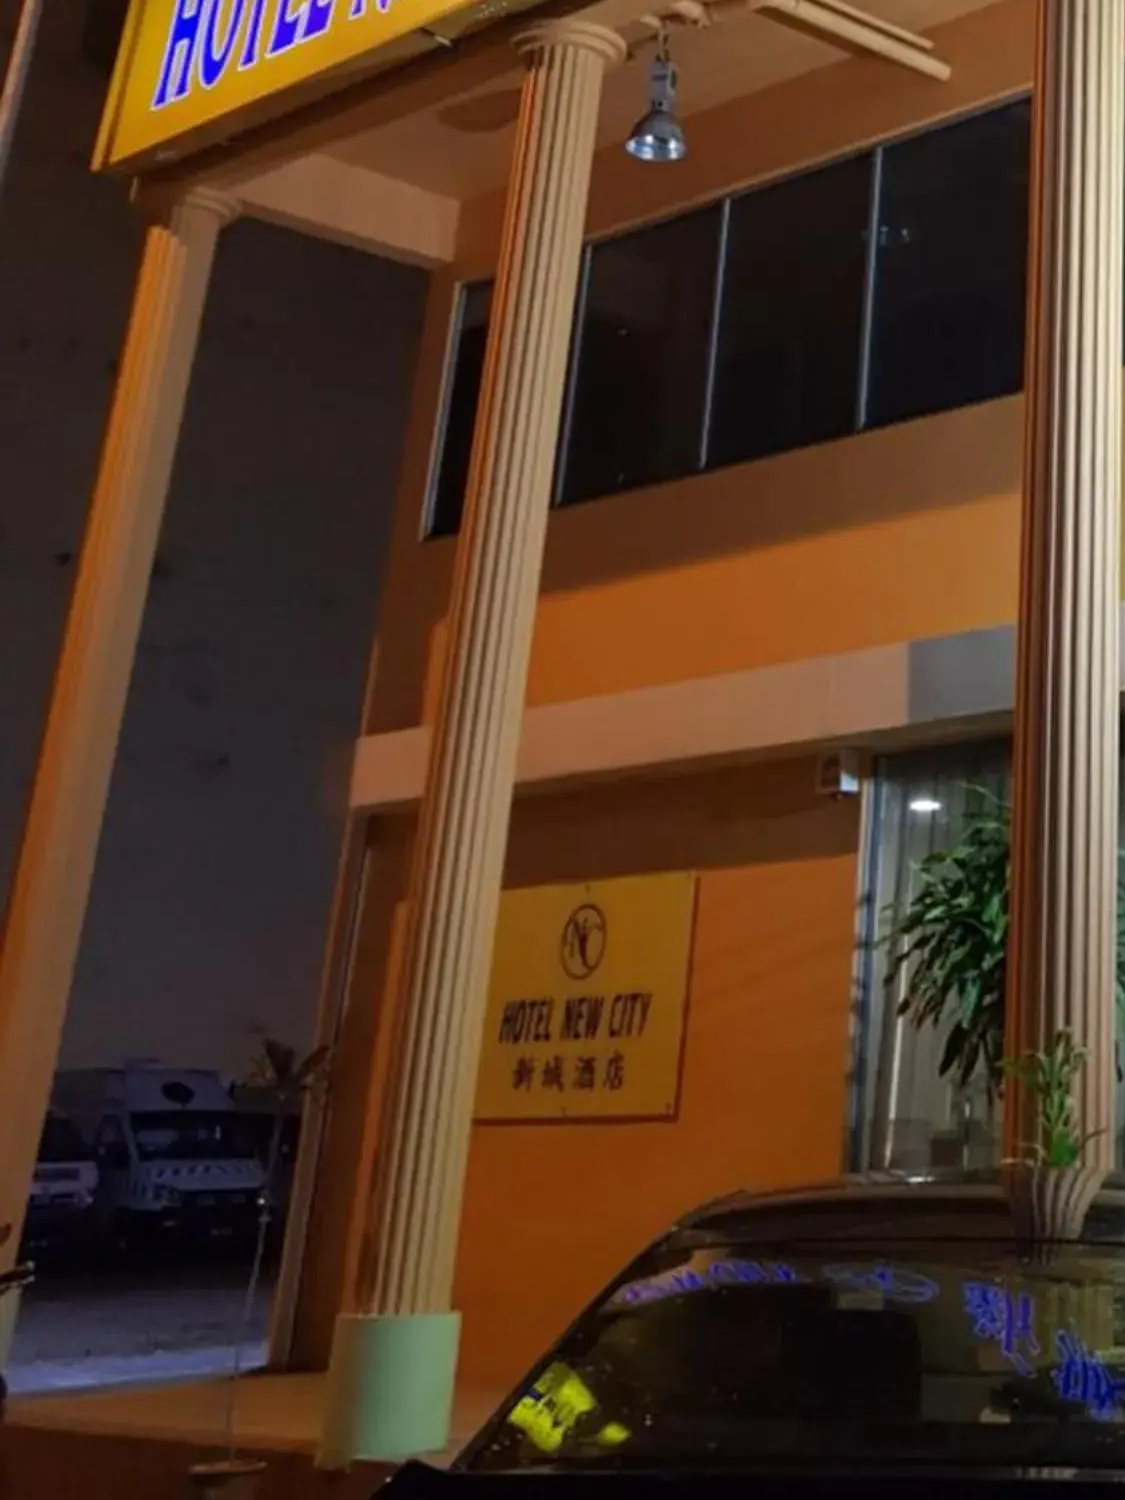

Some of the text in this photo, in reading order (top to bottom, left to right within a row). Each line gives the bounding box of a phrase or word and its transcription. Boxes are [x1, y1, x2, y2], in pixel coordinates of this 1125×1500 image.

[499, 992, 652, 1044] HOTEL NEW CITY
